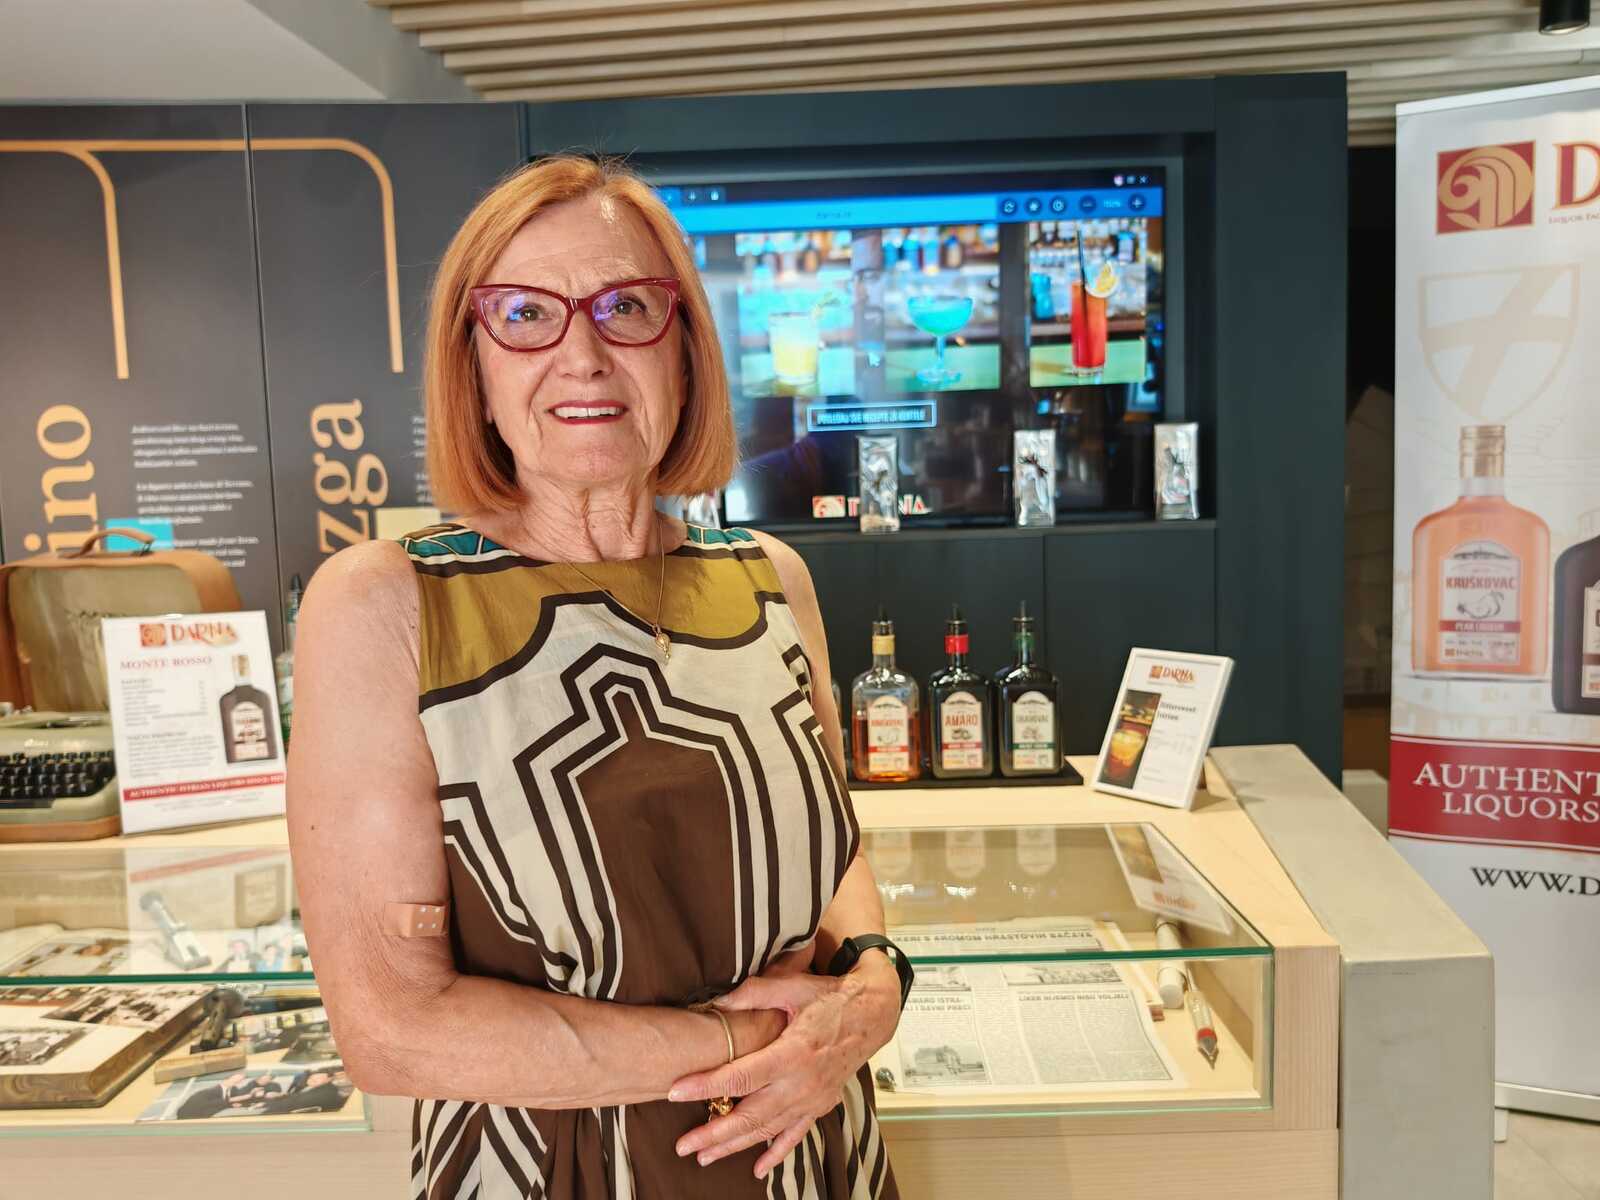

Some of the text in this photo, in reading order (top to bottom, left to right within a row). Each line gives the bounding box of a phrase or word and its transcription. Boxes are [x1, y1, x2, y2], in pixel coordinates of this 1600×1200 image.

[120, 655, 212, 670] MONTE ROSSO
[945, 714, 979, 727] AMARO
[1441, 791, 1600, 823] LIQUORS
